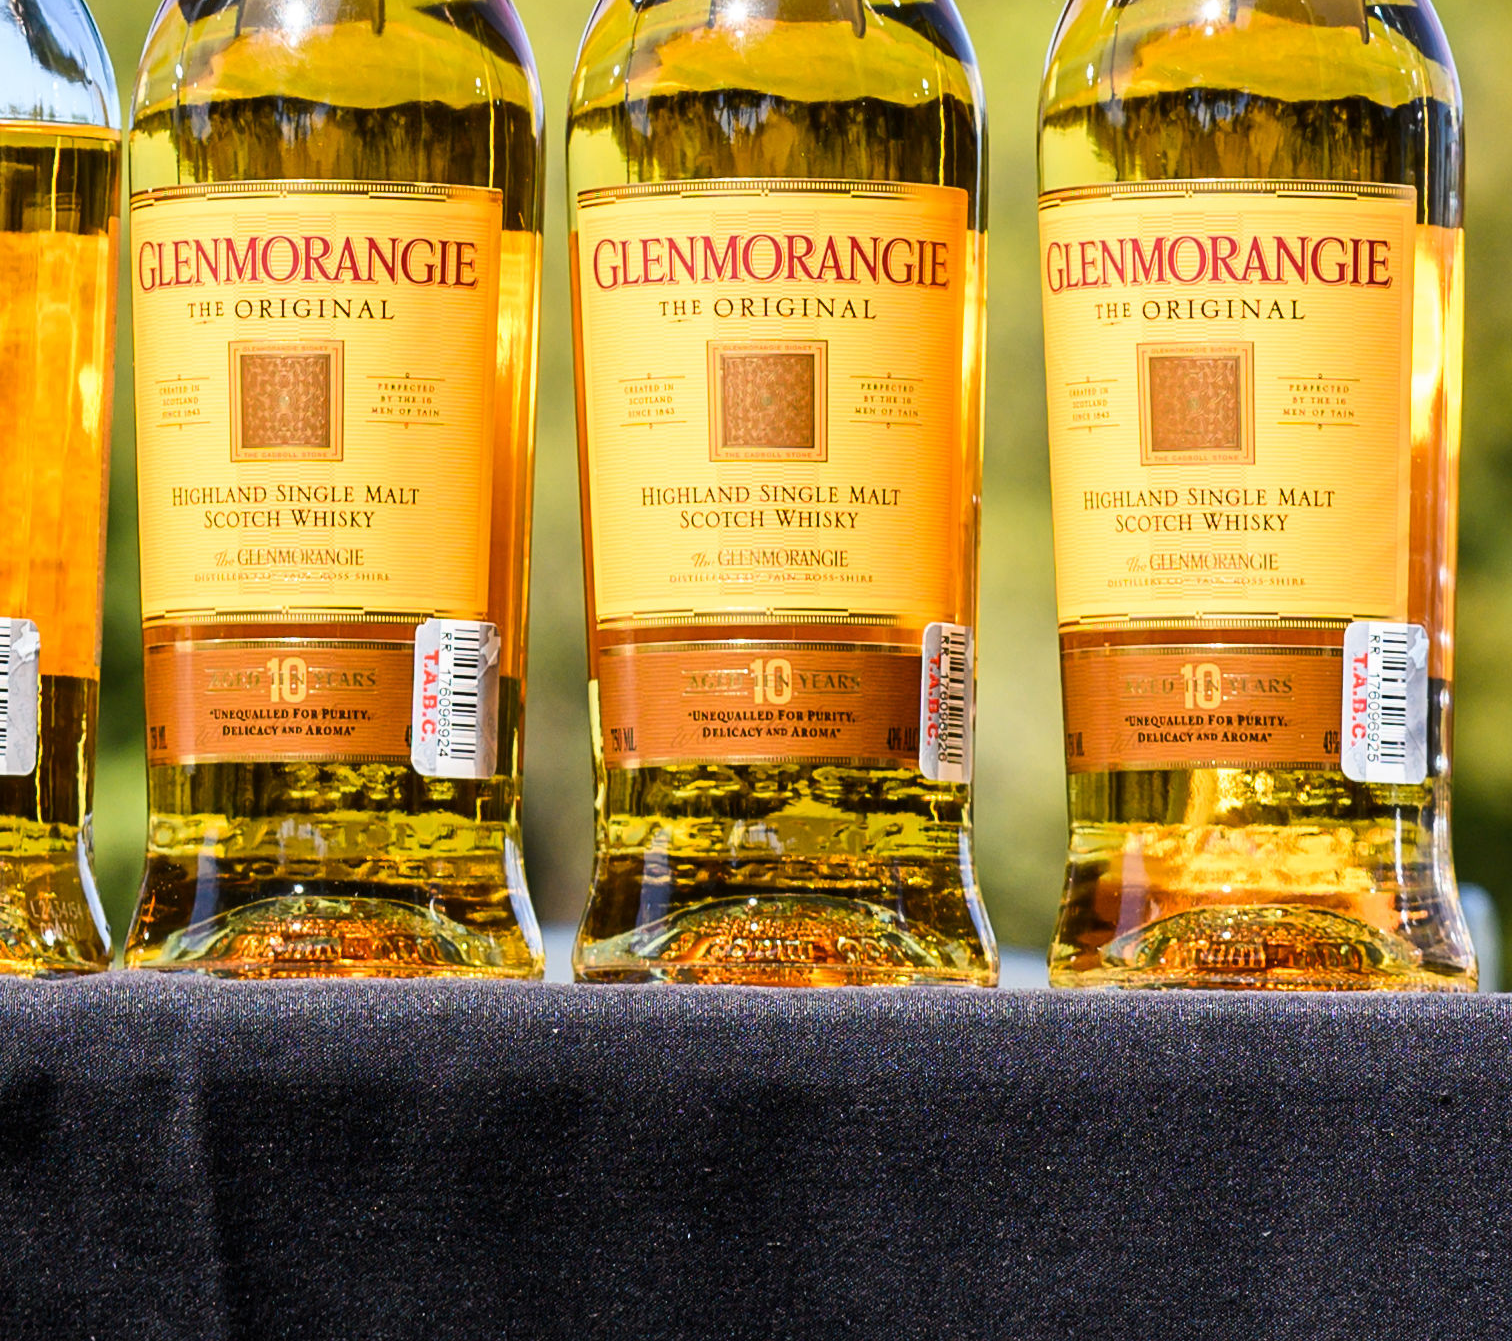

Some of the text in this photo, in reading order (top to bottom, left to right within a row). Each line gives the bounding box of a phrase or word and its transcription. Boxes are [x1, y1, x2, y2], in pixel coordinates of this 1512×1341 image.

[139, 235, 479, 293] GLENMORANGIE
[594, 234, 950, 291] GLENMORANGIE
[1047, 235, 1392, 294] GLENMORANGIE
[188, 298, 395, 320] THE ORIGINAL
[659, 297, 876, 319] THE ORIGINAL
[1095, 299, 1305, 320] THE ORIGINAL
[173, 485, 420, 506] HIGHLAND SINGLE MALT
[642, 485, 900, 506] HIGHLAND SINGLE MALT
[1084, 488, 1335, 510] HIGHLAND SINGLE MALT
[205, 509, 375, 529] SCOTCH WHISKY
[680, 509, 859, 529] SCOTCH WHISKY
[1116, 513, 1288, 533] SCOTCH WHISKY
[238, 549, 364, 566] GLENMORANGIE
[718, 550, 848, 567] GLENMORANGIE
[1150, 553, 1279, 571] GLENMORANGIE
[267, 657, 306, 703] 10
[750, 658, 792, 704] 10
[1180, 663, 1221, 709] 10
[421, 649, 439, 742] T.A.B.C.
[927, 652, 941, 746] T.A.B.C.
[1351, 652, 1367, 747] T.A.B.C.
[293, 709, 318, 719] FOR
[322, 709, 371, 721] PURITY,
[437, 669, 451, 757] 176096924
[778, 710, 802, 721] FOR
[807, 710, 855, 723] PURITY,
[1208, 715, 1233, 726] FOR
[1238, 715, 1288, 728] PURITY,
[1367, 674, 1381, 763] 176096925
[222, 725, 278, 735] DELICACY
[702, 727, 761, 738] DELICACY
[766, 728, 787, 736] AND
[1138, 732, 1193, 743] DELICACY
[1197, 733, 1218, 741] AND
